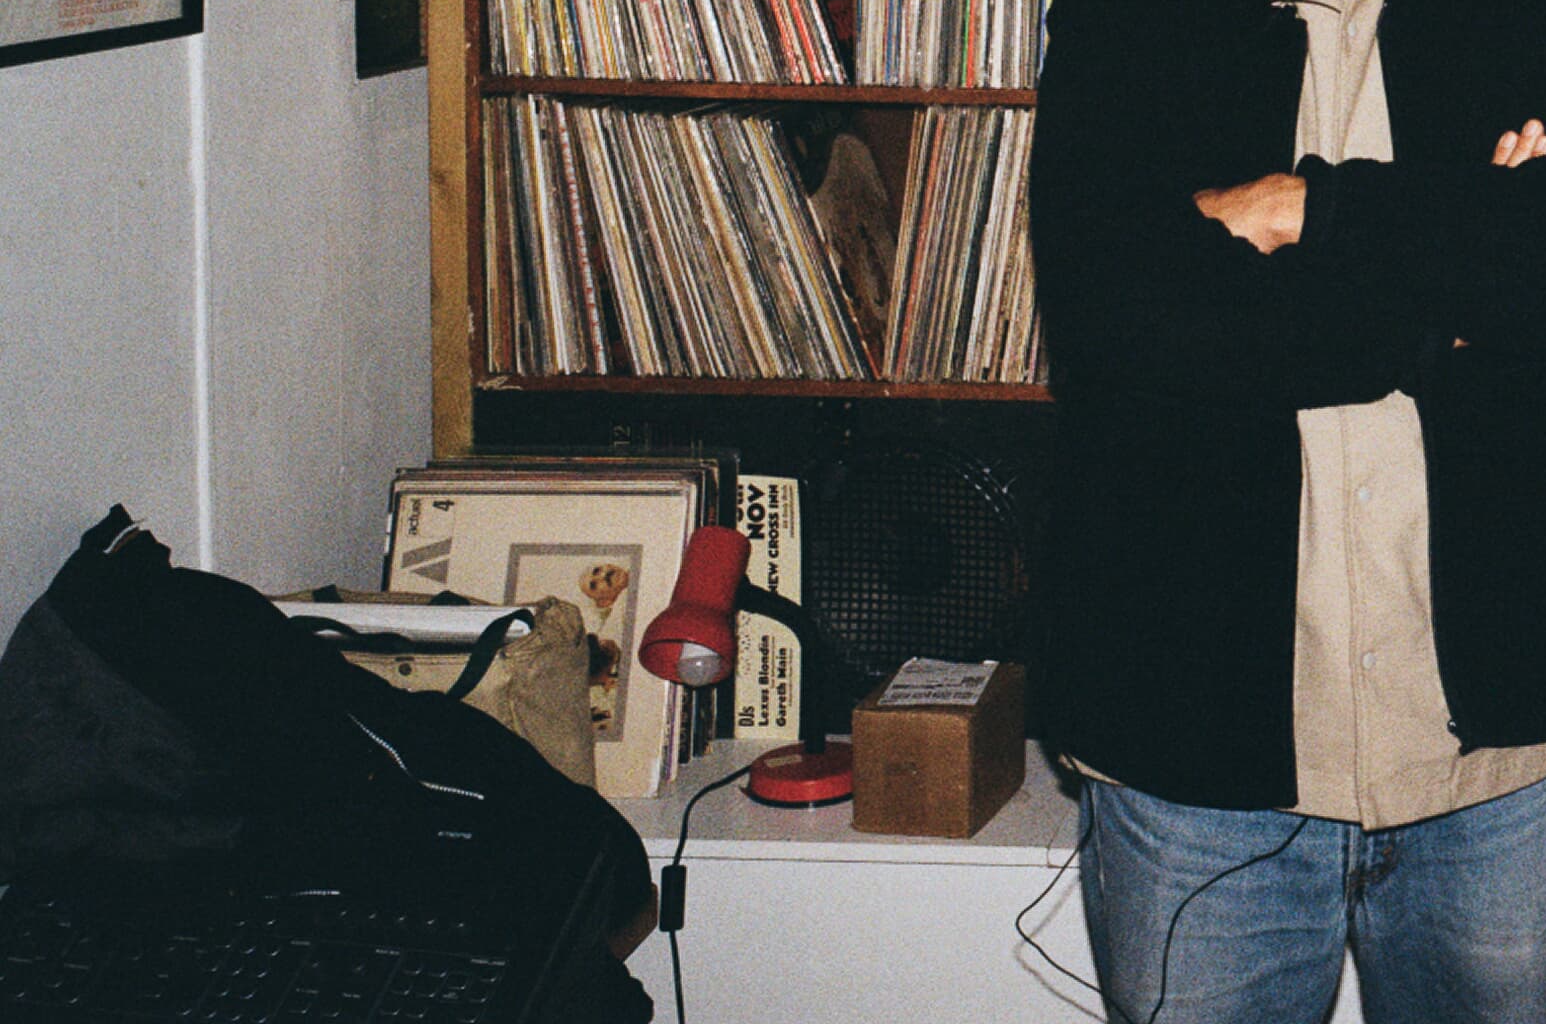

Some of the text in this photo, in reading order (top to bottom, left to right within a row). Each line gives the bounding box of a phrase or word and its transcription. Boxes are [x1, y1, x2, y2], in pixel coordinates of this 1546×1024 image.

[431, 499, 455, 512] 4
[746, 484, 766, 540] NOV
[768, 484, 779, 593] NEW CROSS INN
[758, 635, 769, 726] Lexus Blondin
[775, 648, 787, 727] Gareth Main
[737, 705, 756, 727] DJs
